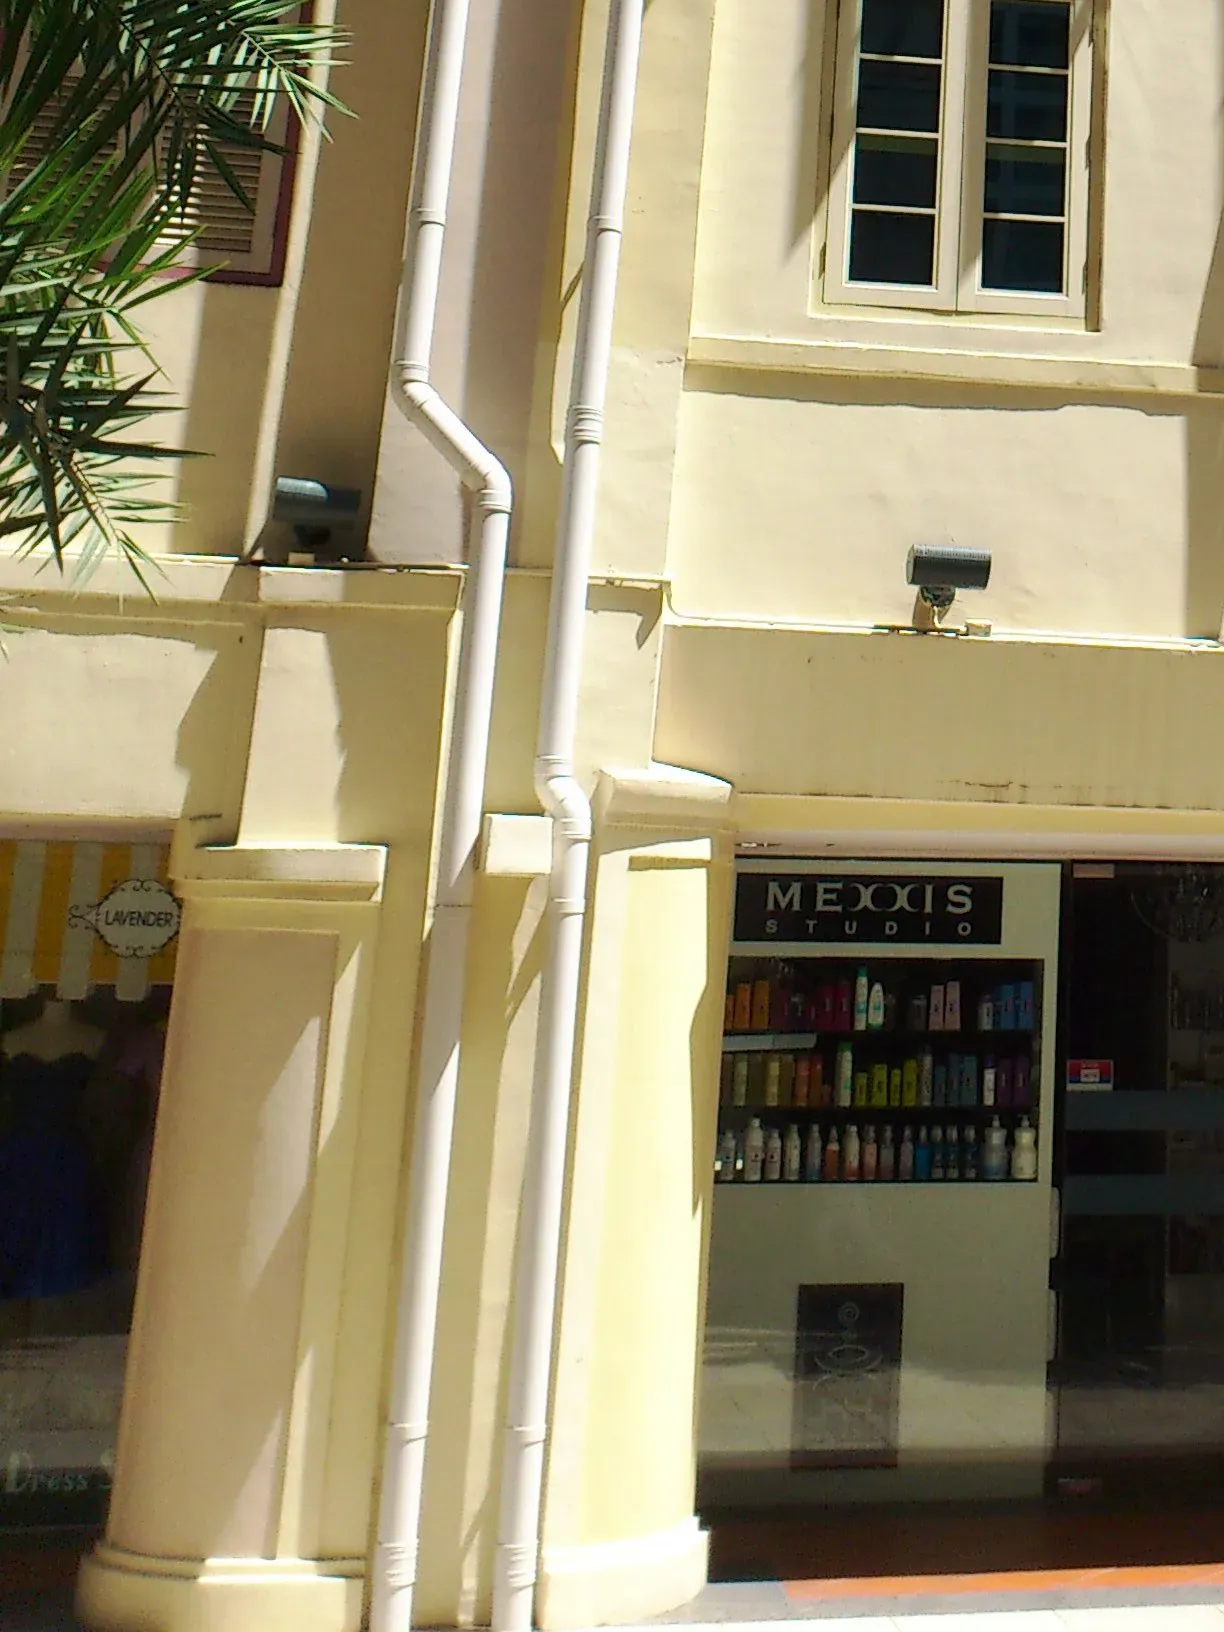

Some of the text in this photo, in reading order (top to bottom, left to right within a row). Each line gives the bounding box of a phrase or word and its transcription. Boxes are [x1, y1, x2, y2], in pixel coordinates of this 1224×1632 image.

[765, 880, 974, 915] MEXXIS
[104, 910, 174, 928] LAVENDER
[764, 919, 973, 936] STUDIO
[5, 1450, 89, 1494] Dress
